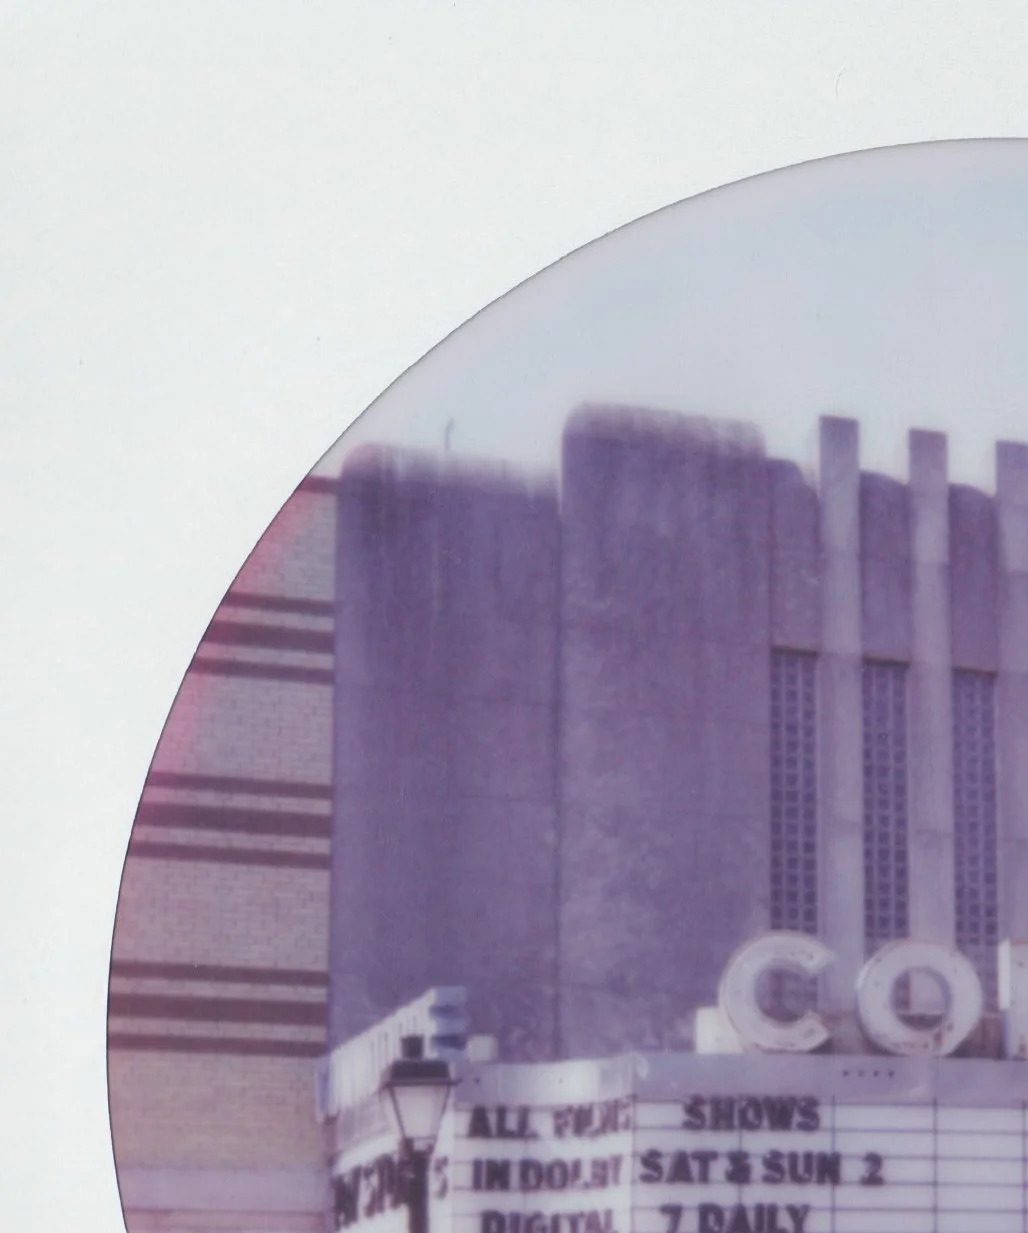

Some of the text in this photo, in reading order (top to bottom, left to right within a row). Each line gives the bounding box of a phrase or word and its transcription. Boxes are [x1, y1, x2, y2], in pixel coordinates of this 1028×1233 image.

[467, 1104, 540, 1140] ALL
[682, 1092, 821, 1132] SHOWS
[472, 1157, 511, 1191] IN
[639, 1149, 719, 1184] SAT
[761, 1149, 842, 1186] SUN
[860, 1151, 886, 1186] 2
